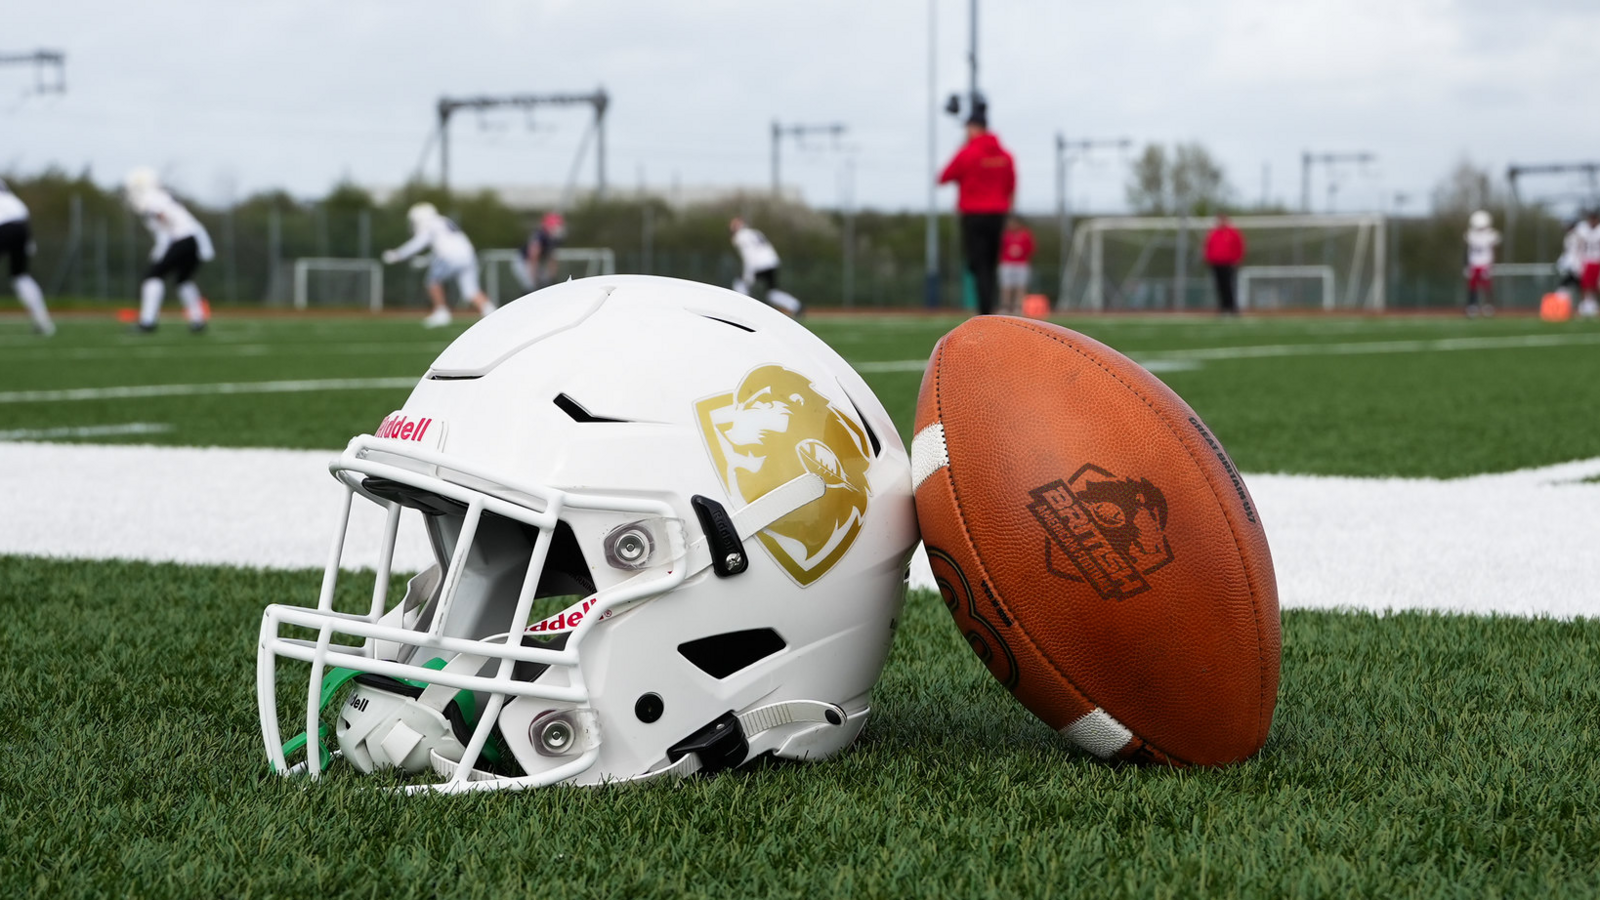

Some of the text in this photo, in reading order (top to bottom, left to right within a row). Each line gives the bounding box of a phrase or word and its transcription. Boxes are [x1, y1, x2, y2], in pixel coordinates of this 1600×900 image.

[1188, 416, 1219, 450] GREAT
[1216, 452, 1246, 500] BRITAIN
[1035, 504, 1082, 553] AMERICAN
[1042, 485, 1144, 593] BRITISH
